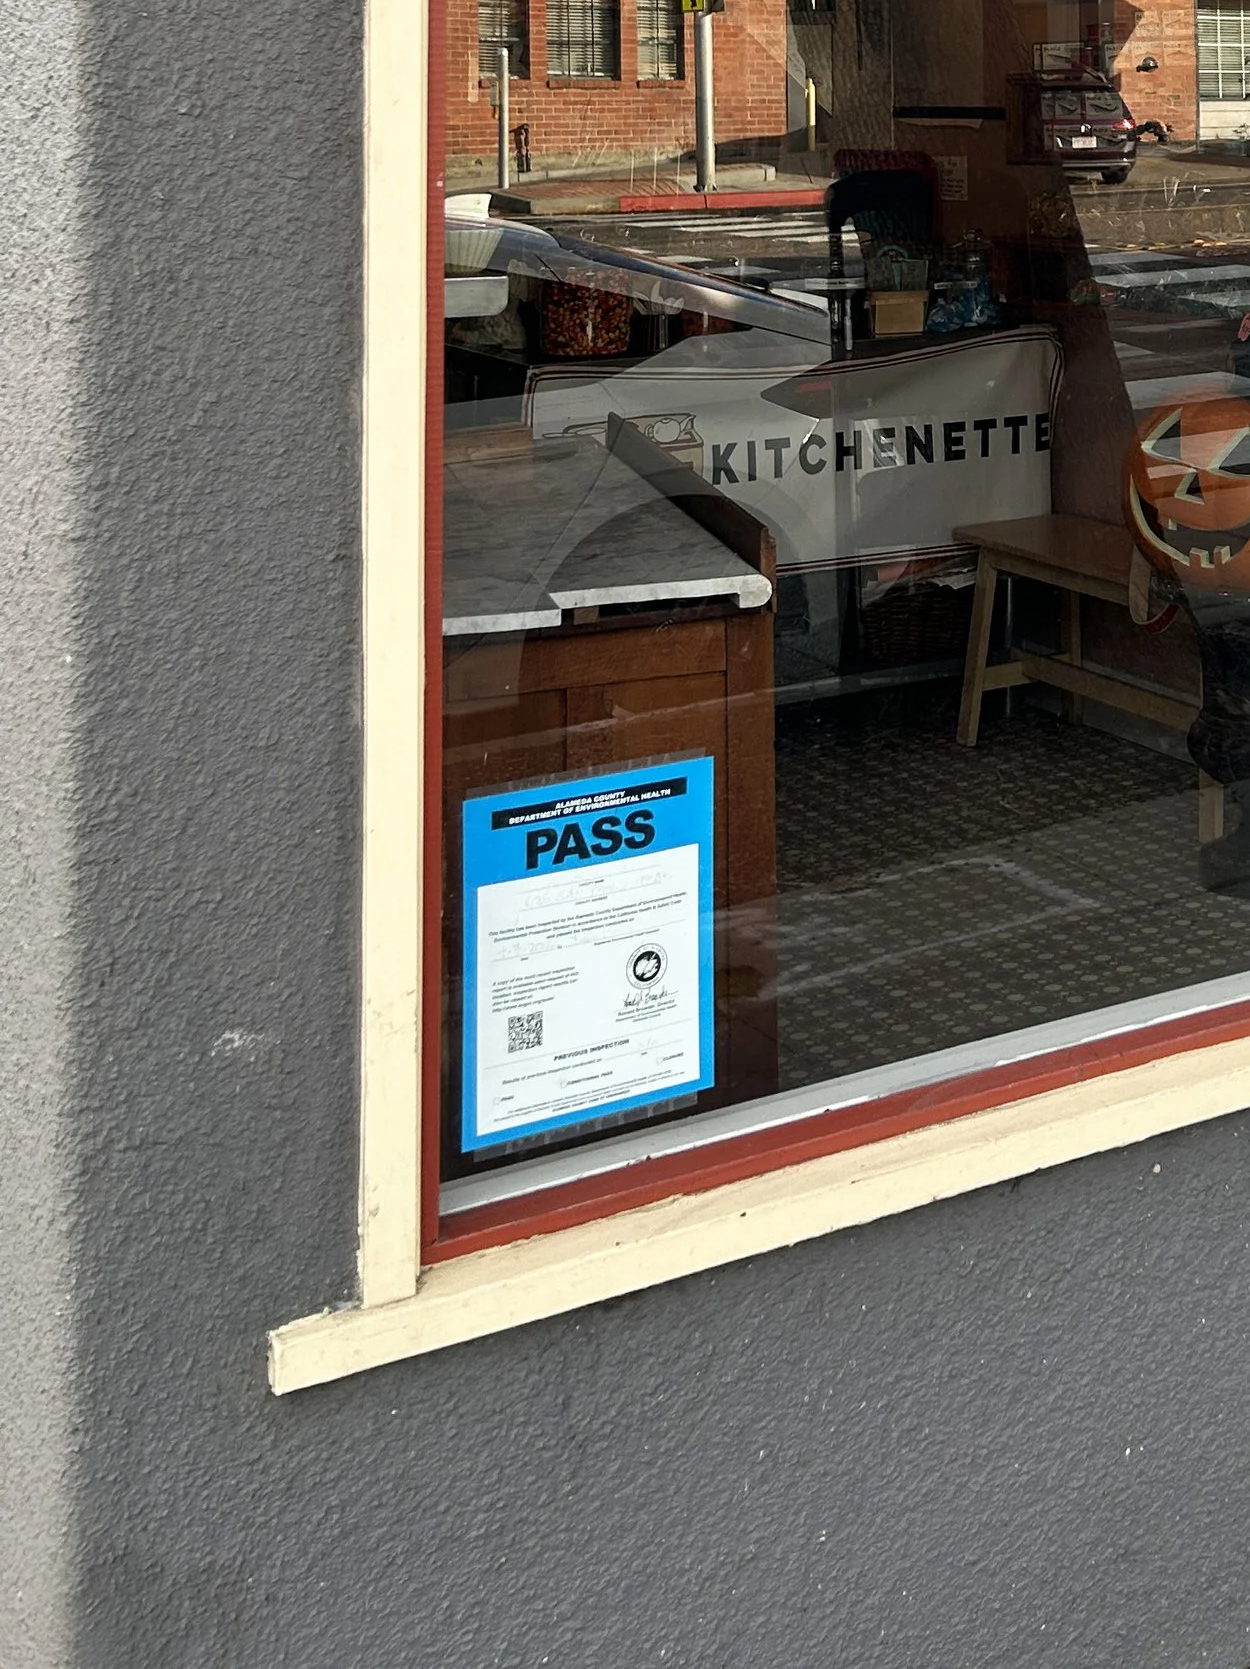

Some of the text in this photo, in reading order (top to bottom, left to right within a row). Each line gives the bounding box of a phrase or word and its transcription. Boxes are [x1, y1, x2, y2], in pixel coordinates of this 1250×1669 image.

[711, 411, 1050, 486] KITCHENETTE
[508, 788, 671, 826] DEPARTMENT OF ENVIRONMENTAL HEALTH
[554, 790, 626, 810] ALAMEDA COUNTY
[525, 808, 656, 871] PASS
